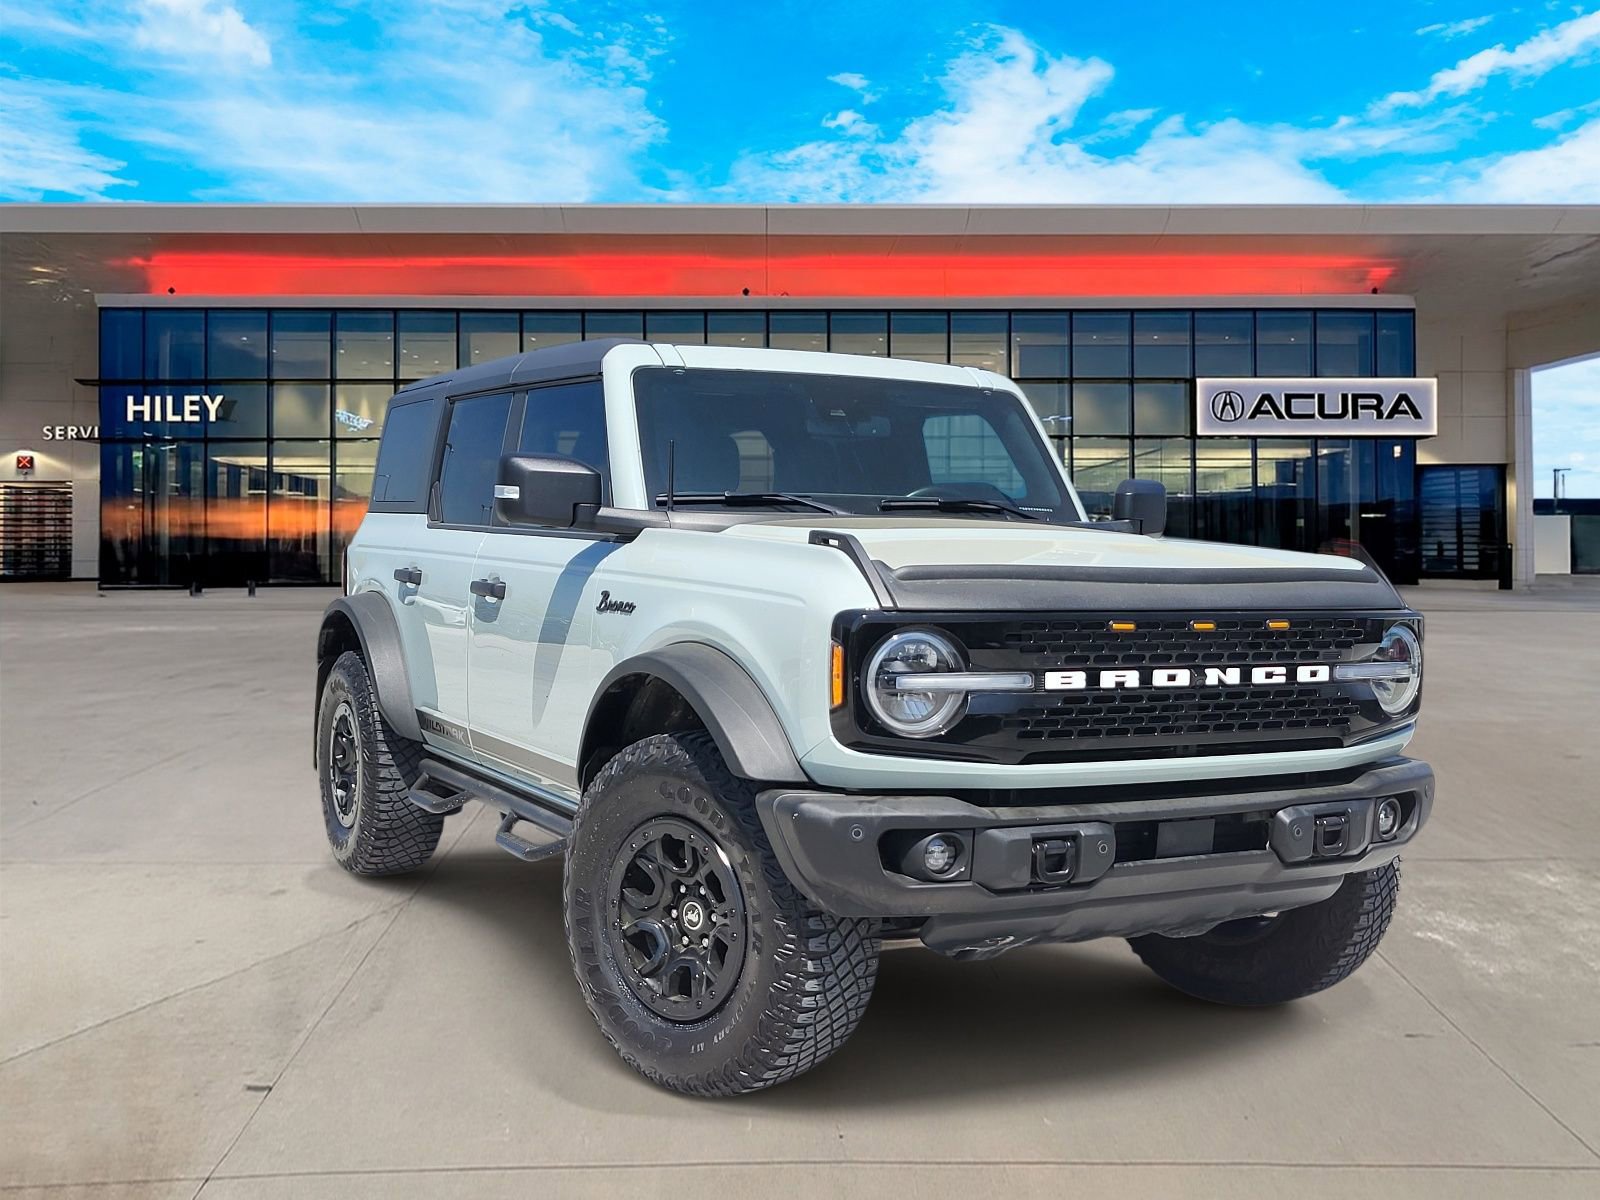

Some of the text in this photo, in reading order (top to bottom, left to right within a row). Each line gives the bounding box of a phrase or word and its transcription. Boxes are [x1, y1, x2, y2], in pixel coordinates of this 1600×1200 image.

[126, 395, 224, 422] HILEY
[1248, 393, 1422, 419] ACURA
[596, 590, 637, 614] Bronco
[1044, 665, 1331, 690] BRONCO
